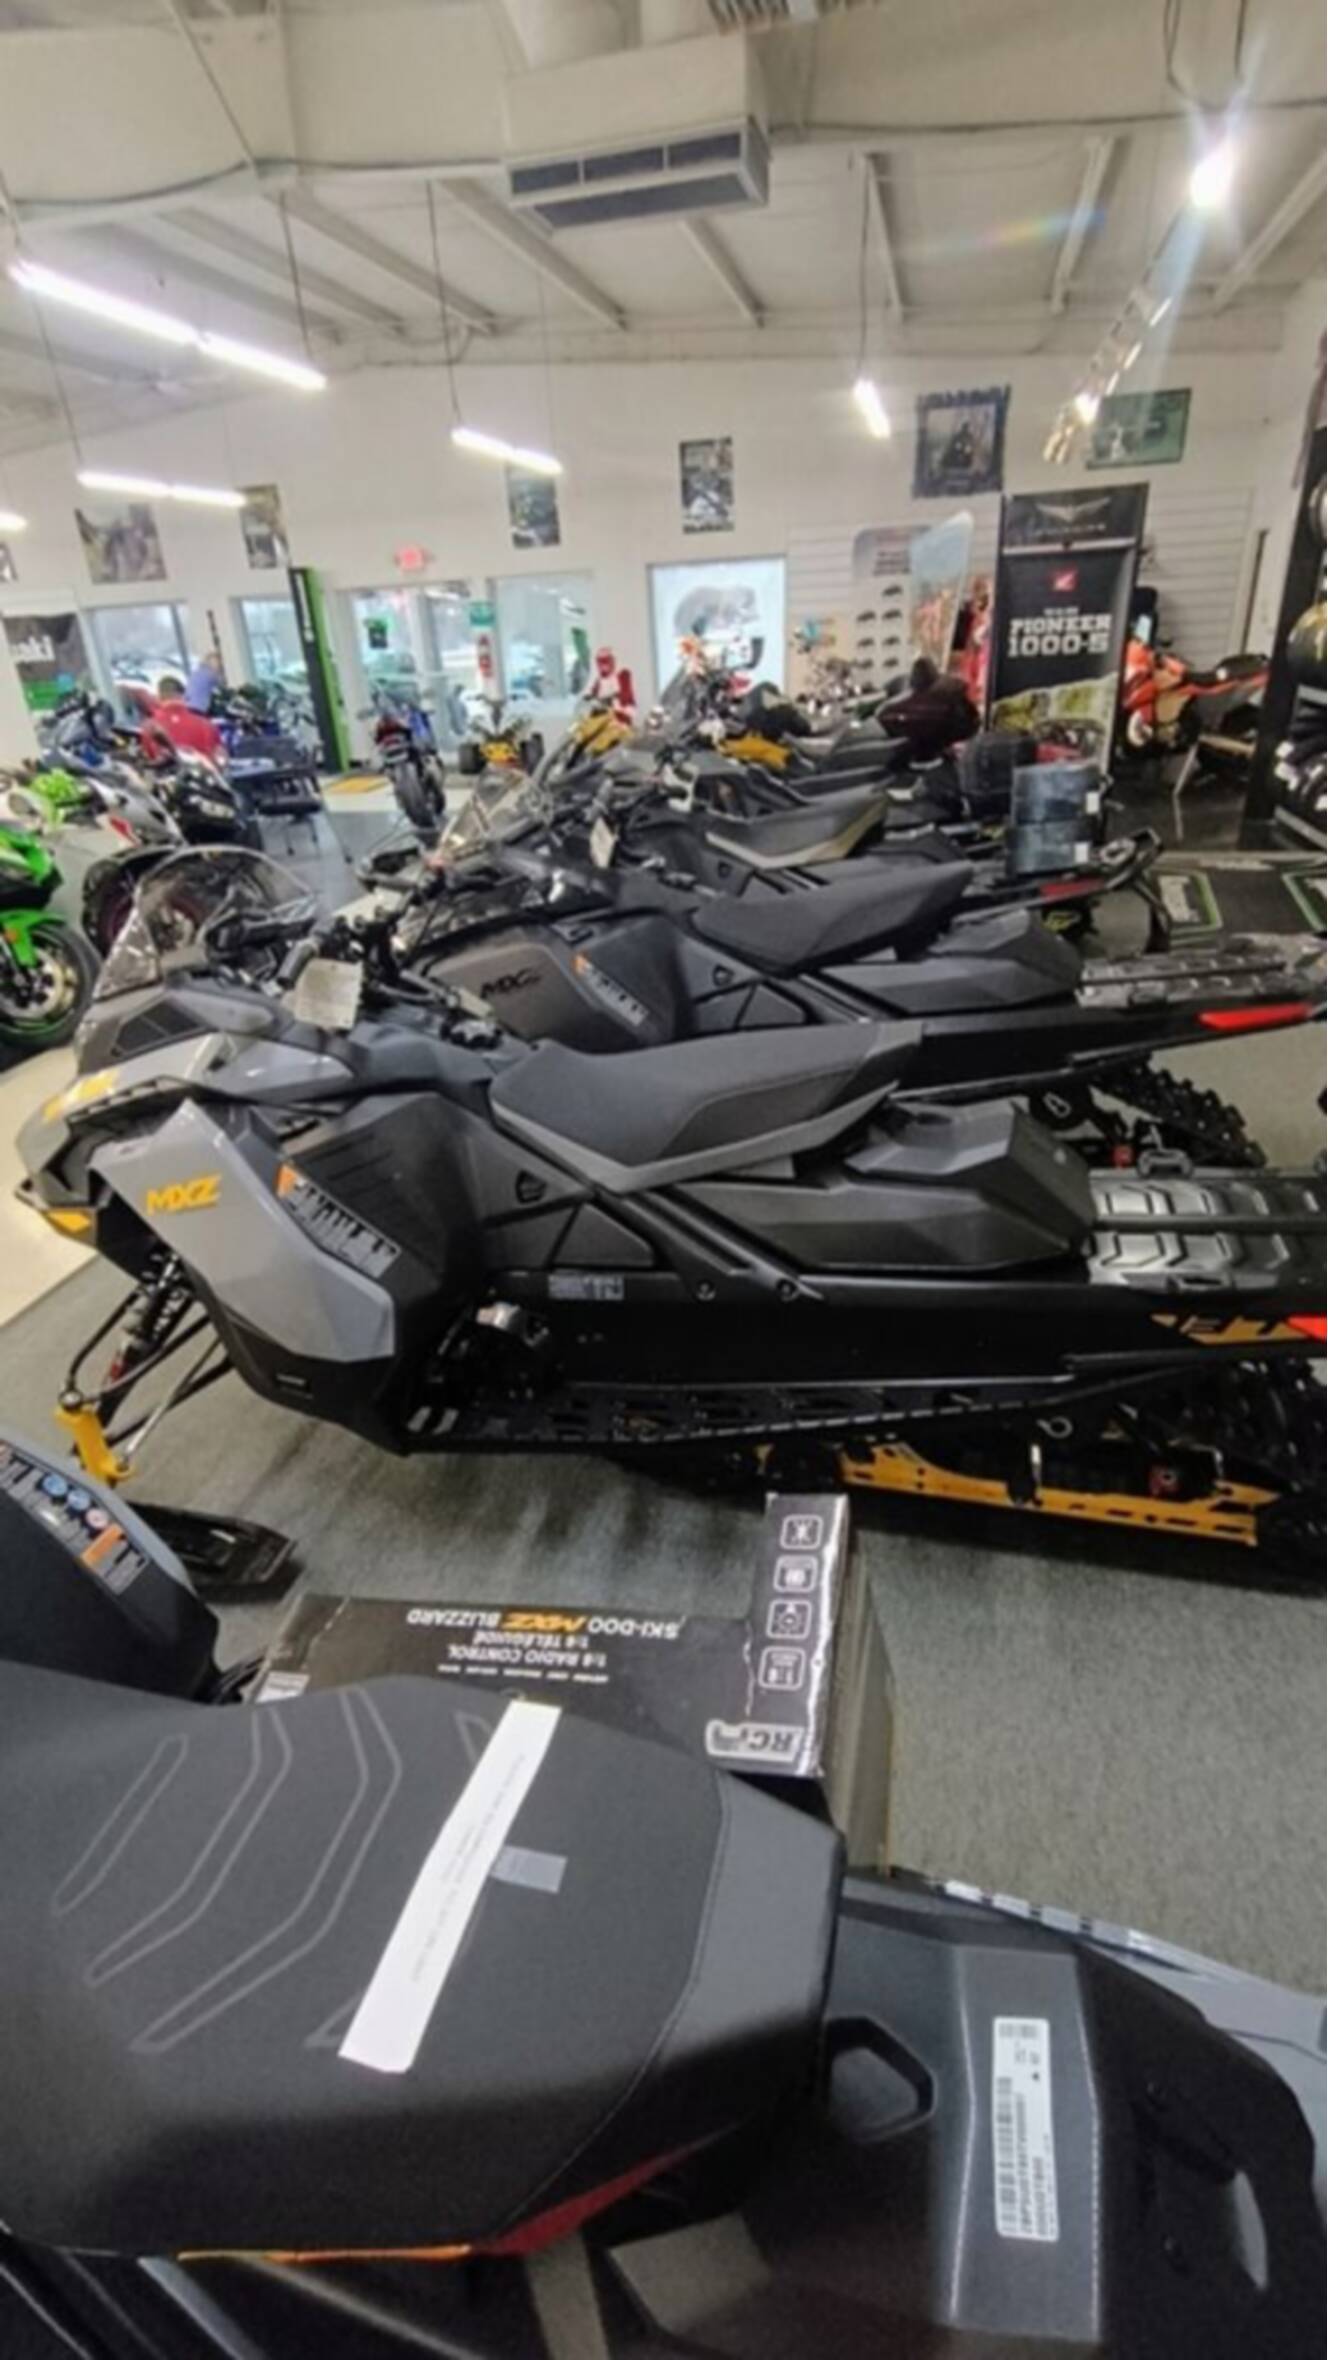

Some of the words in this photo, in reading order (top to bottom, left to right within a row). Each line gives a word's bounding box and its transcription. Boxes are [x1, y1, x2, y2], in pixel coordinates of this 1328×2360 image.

[1009, 613, 1112, 636] PIONEER
[147, 1175, 221, 1214] MXZ
[406, 1608, 501, 1628] BLIZZARD
[501, 1611, 587, 1632] MXZ
[588, 1616, 680, 1639] SKI-DOO
[448, 1644, 522, 1663] CONTROL
[525, 1650, 580, 1666] RADIO
